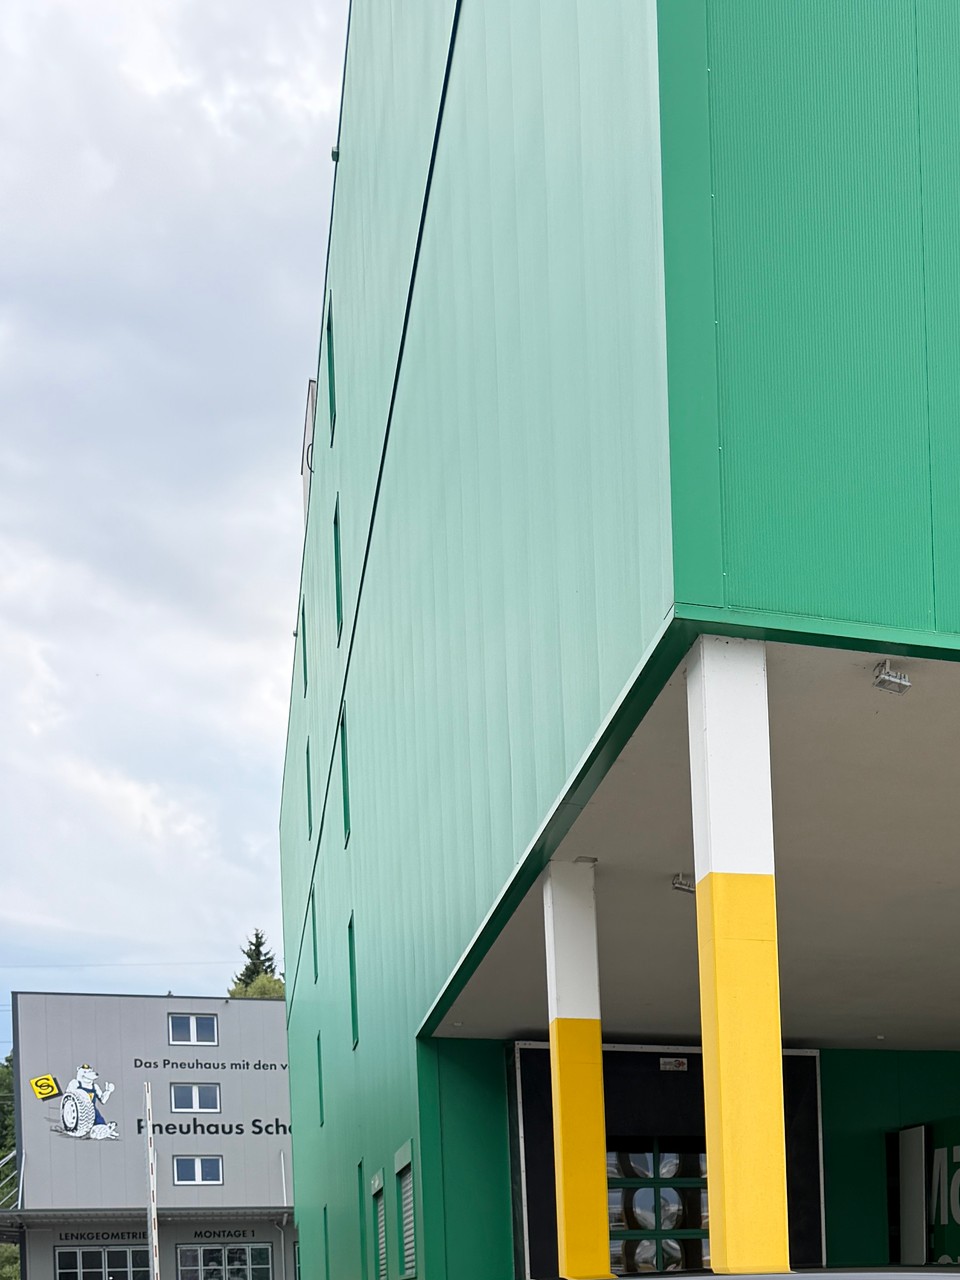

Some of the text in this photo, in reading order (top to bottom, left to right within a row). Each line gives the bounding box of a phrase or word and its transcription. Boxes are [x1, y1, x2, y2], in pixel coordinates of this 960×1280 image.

[134, 1058, 159, 1069] Das
[162, 1059, 227, 1070] Pneuhaus
[230, 1059, 250, 1070] mit
[253, 1060, 277, 1071] den
[251, 1117, 293, 1135] Sch
[59, 1231, 148, 1241] LENKGEOMETRIE
[193, 1230, 246, 1239] MONTAGE
